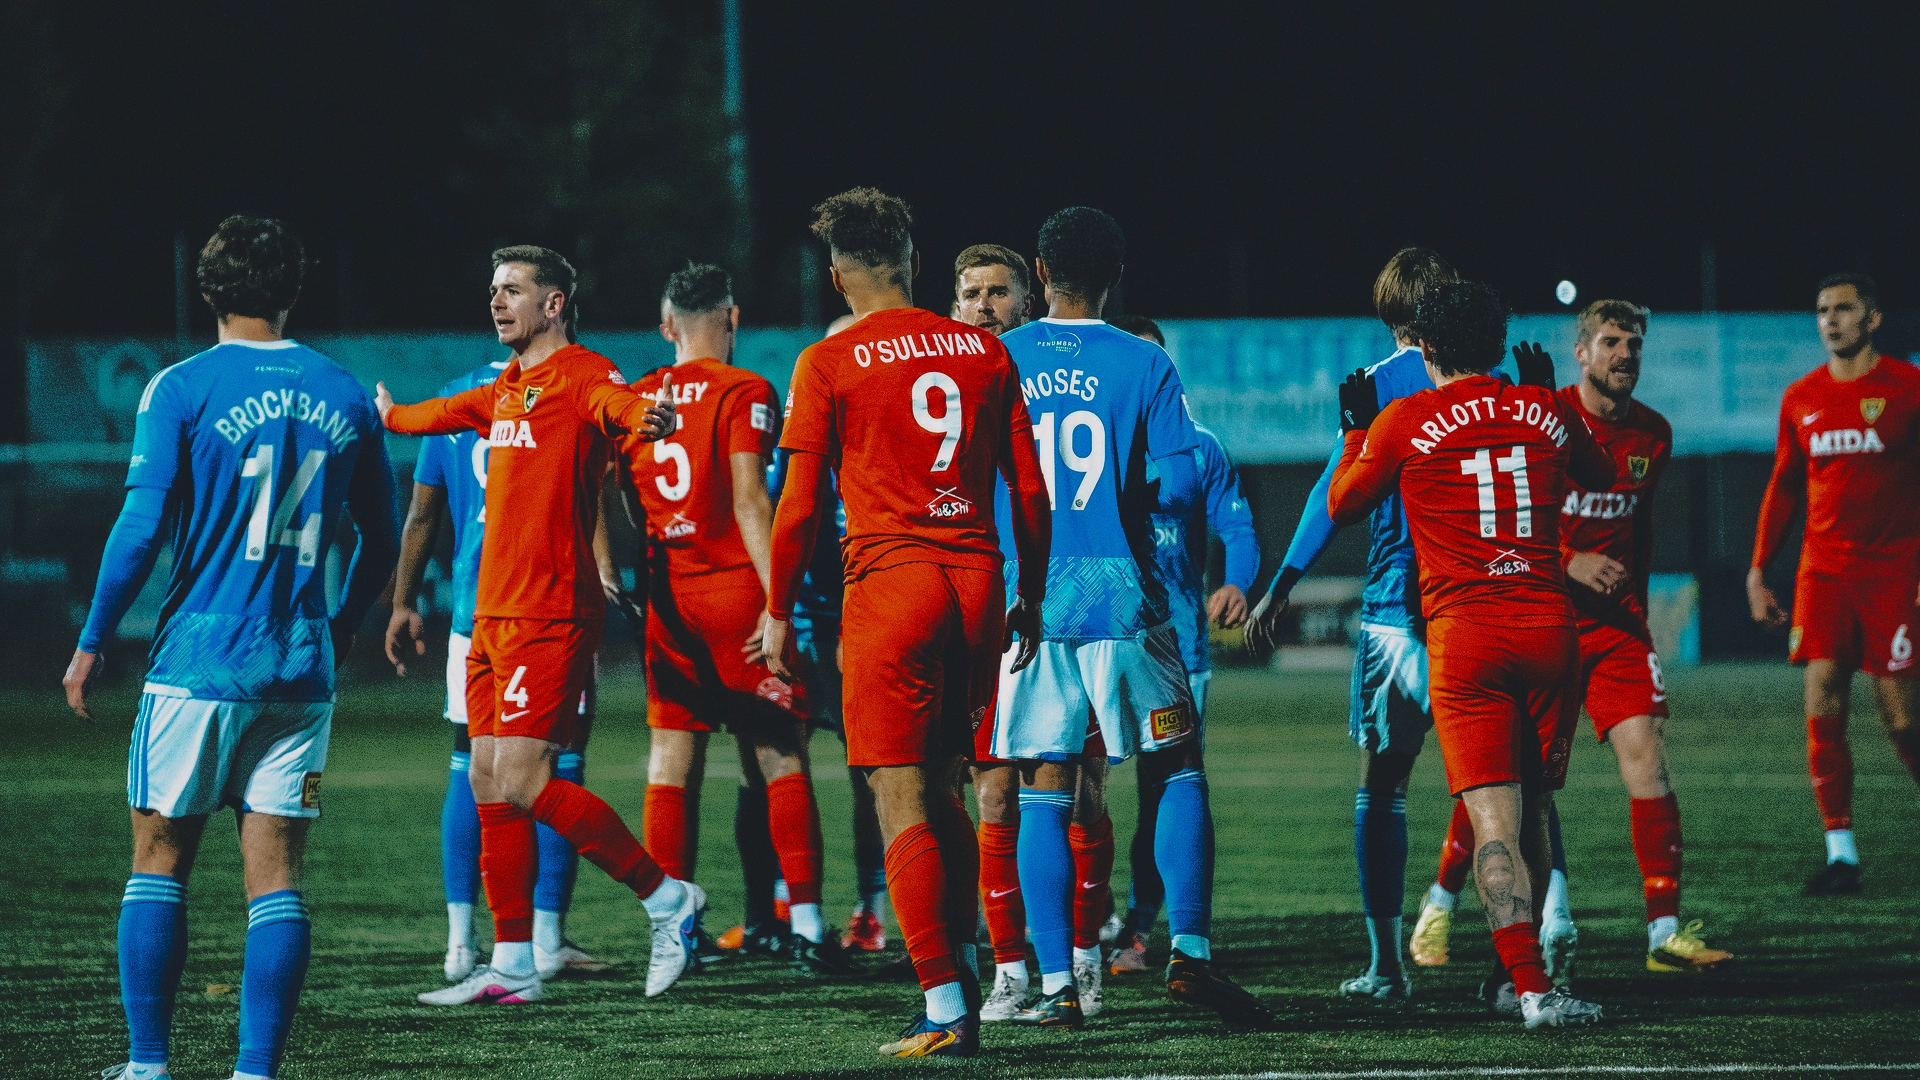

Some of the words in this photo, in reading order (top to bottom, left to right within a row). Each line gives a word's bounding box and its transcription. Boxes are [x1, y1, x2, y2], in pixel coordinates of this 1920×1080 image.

[854, 333, 986, 368] O'SULLIVAN
[1020, 368, 1098, 406] MOSES
[214, 388, 358, 454] BROCKBANK
[911, 371, 962, 473] 9
[1410, 397, 1569, 454] ARLOTT-JOHN
[1810, 428, 1885, 457] MIDA
[654, 414, 691, 501] 5
[1032, 410, 1106, 511] 19
[240, 444, 327, 567] 14
[929, 502, 969, 517] Su&Shi
[1460, 446, 1532, 538] 11
[1488, 561, 1531, 576] Su&Shi
[1890, 623, 1912, 660] 6
[503, 665, 529, 708] 4
[1647, 652, 1665, 691] 8
